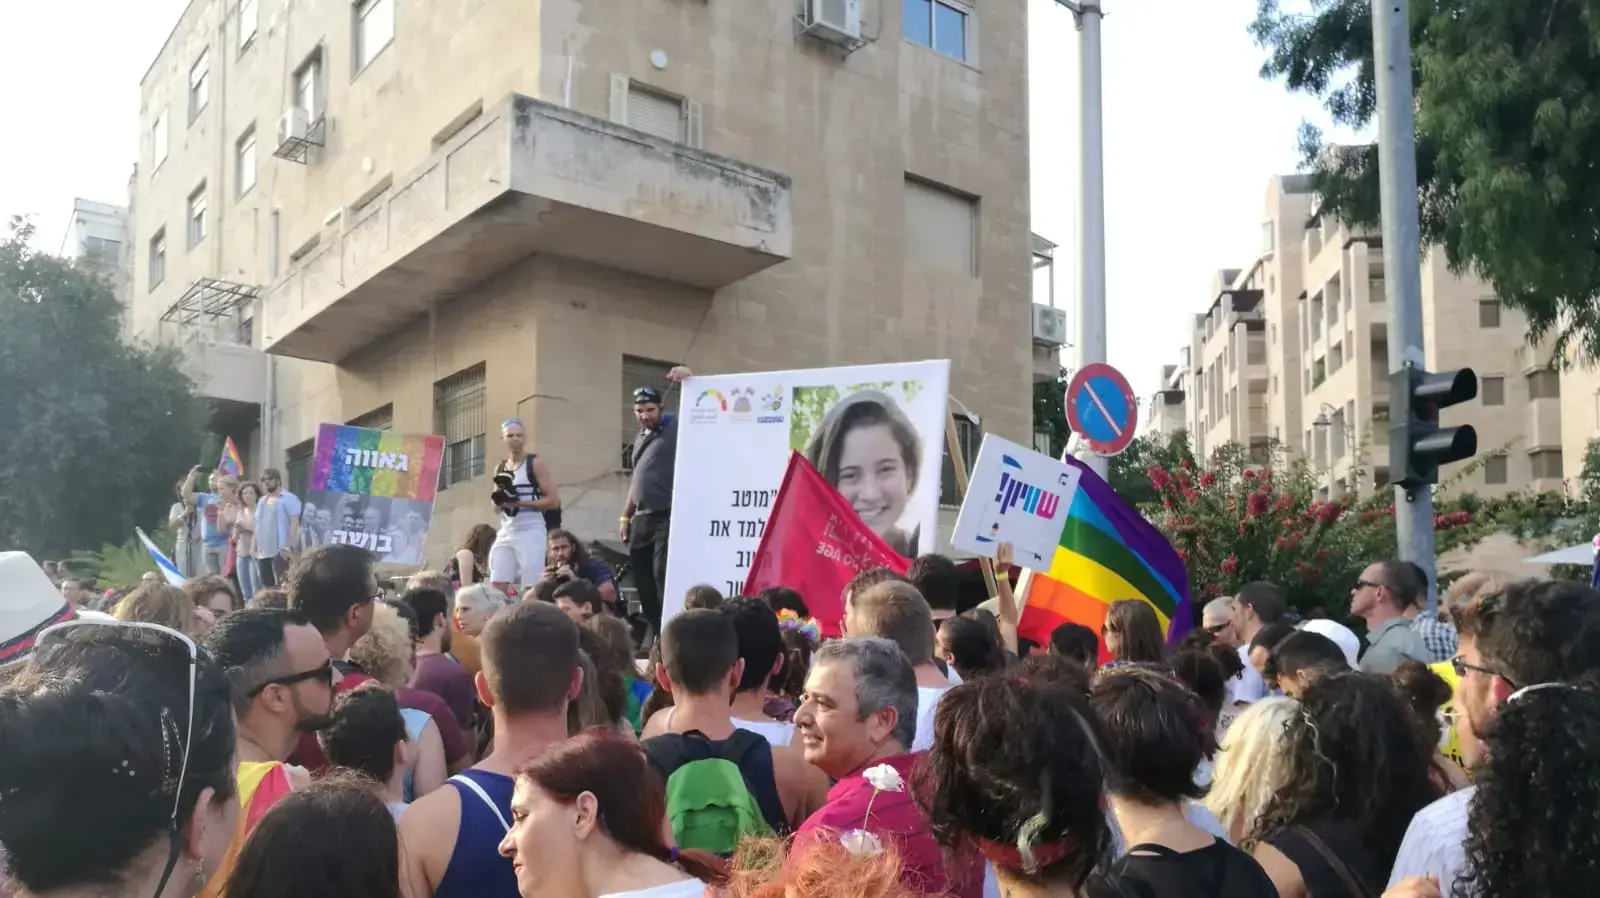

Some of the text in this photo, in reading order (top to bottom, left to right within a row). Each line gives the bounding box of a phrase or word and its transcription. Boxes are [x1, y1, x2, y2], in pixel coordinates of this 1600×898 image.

[344, 448, 409, 471] גאווה
[709, 519, 731, 538] את
[331, 529, 392, 553] בושה
